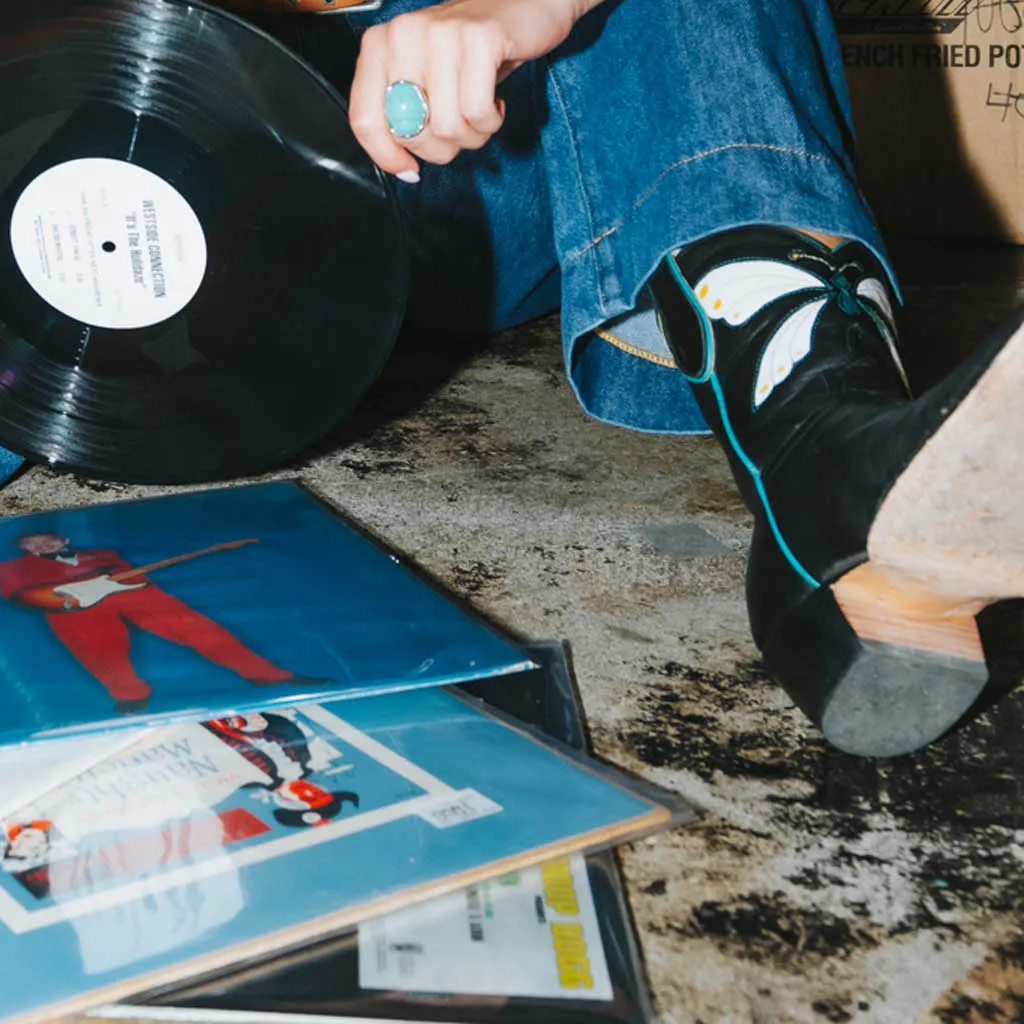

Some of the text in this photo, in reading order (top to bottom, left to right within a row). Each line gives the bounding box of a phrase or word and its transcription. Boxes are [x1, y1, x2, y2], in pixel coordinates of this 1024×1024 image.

[843, 44, 903, 68] ENCH
[911, 44, 981, 68] FRIED
[142, 199, 167, 298] WESTSIDE CONNECTION
